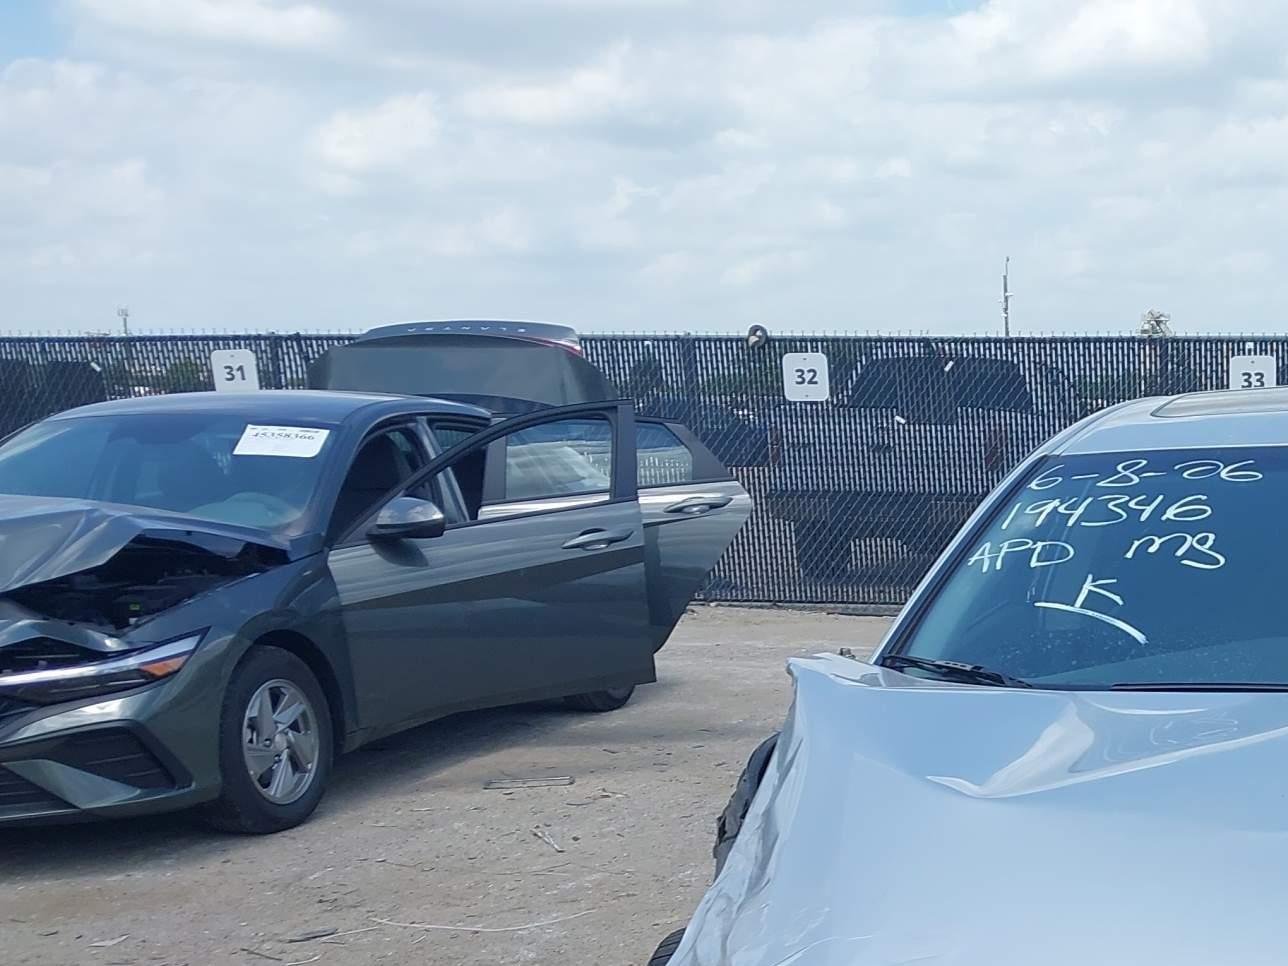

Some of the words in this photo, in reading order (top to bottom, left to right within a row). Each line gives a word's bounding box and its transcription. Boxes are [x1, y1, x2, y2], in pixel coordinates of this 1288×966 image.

[223, 365, 247, 382] 31
[795, 368, 818, 385] 32
[1241, 371, 1265, 388] 33
[1001, 495, 1213, 530] 194346
[967, 538, 1075, 573] APD
